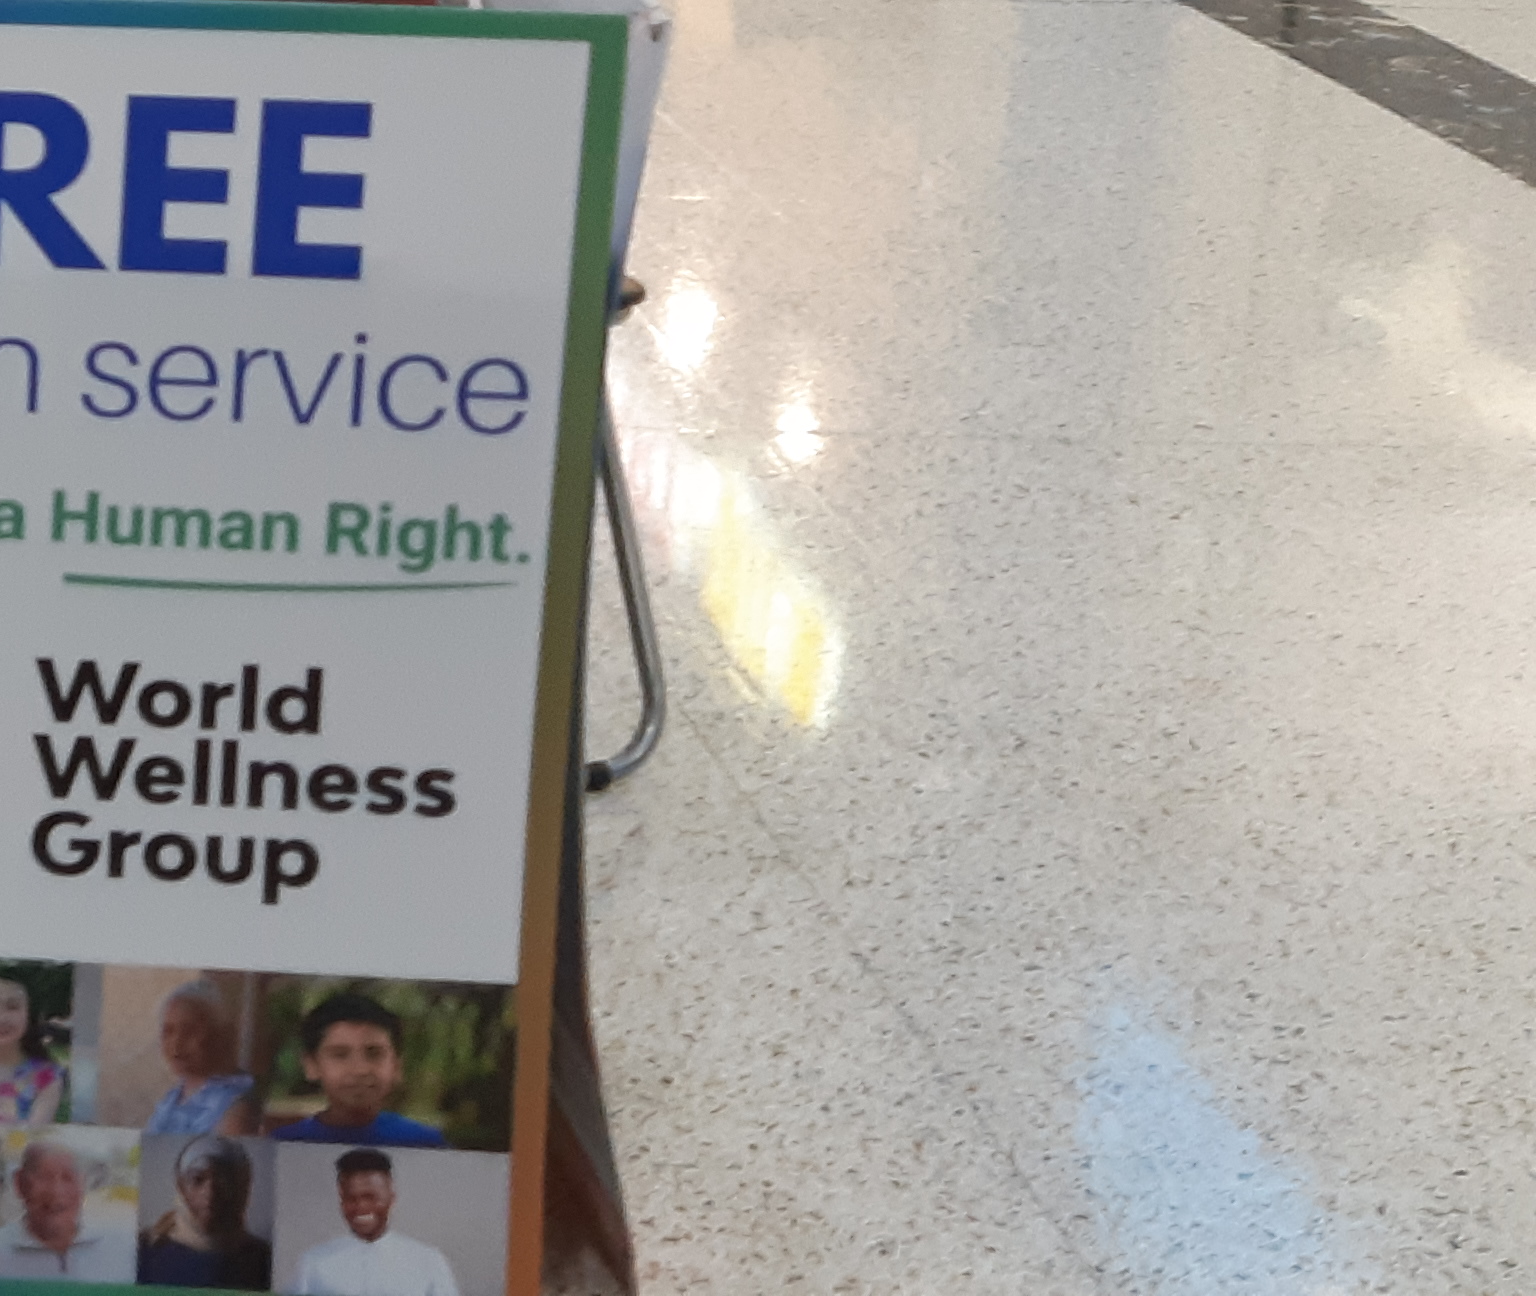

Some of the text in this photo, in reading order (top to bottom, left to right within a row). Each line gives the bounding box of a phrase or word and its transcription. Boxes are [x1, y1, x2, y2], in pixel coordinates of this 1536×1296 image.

[80, 332, 530, 437] service
[50, 491, 300, 555] Human
[325, 503, 530, 574] Right.
[35, 657, 323, 736] World
[33, 733, 457, 819] Wellness
[31, 810, 321, 905] Group
